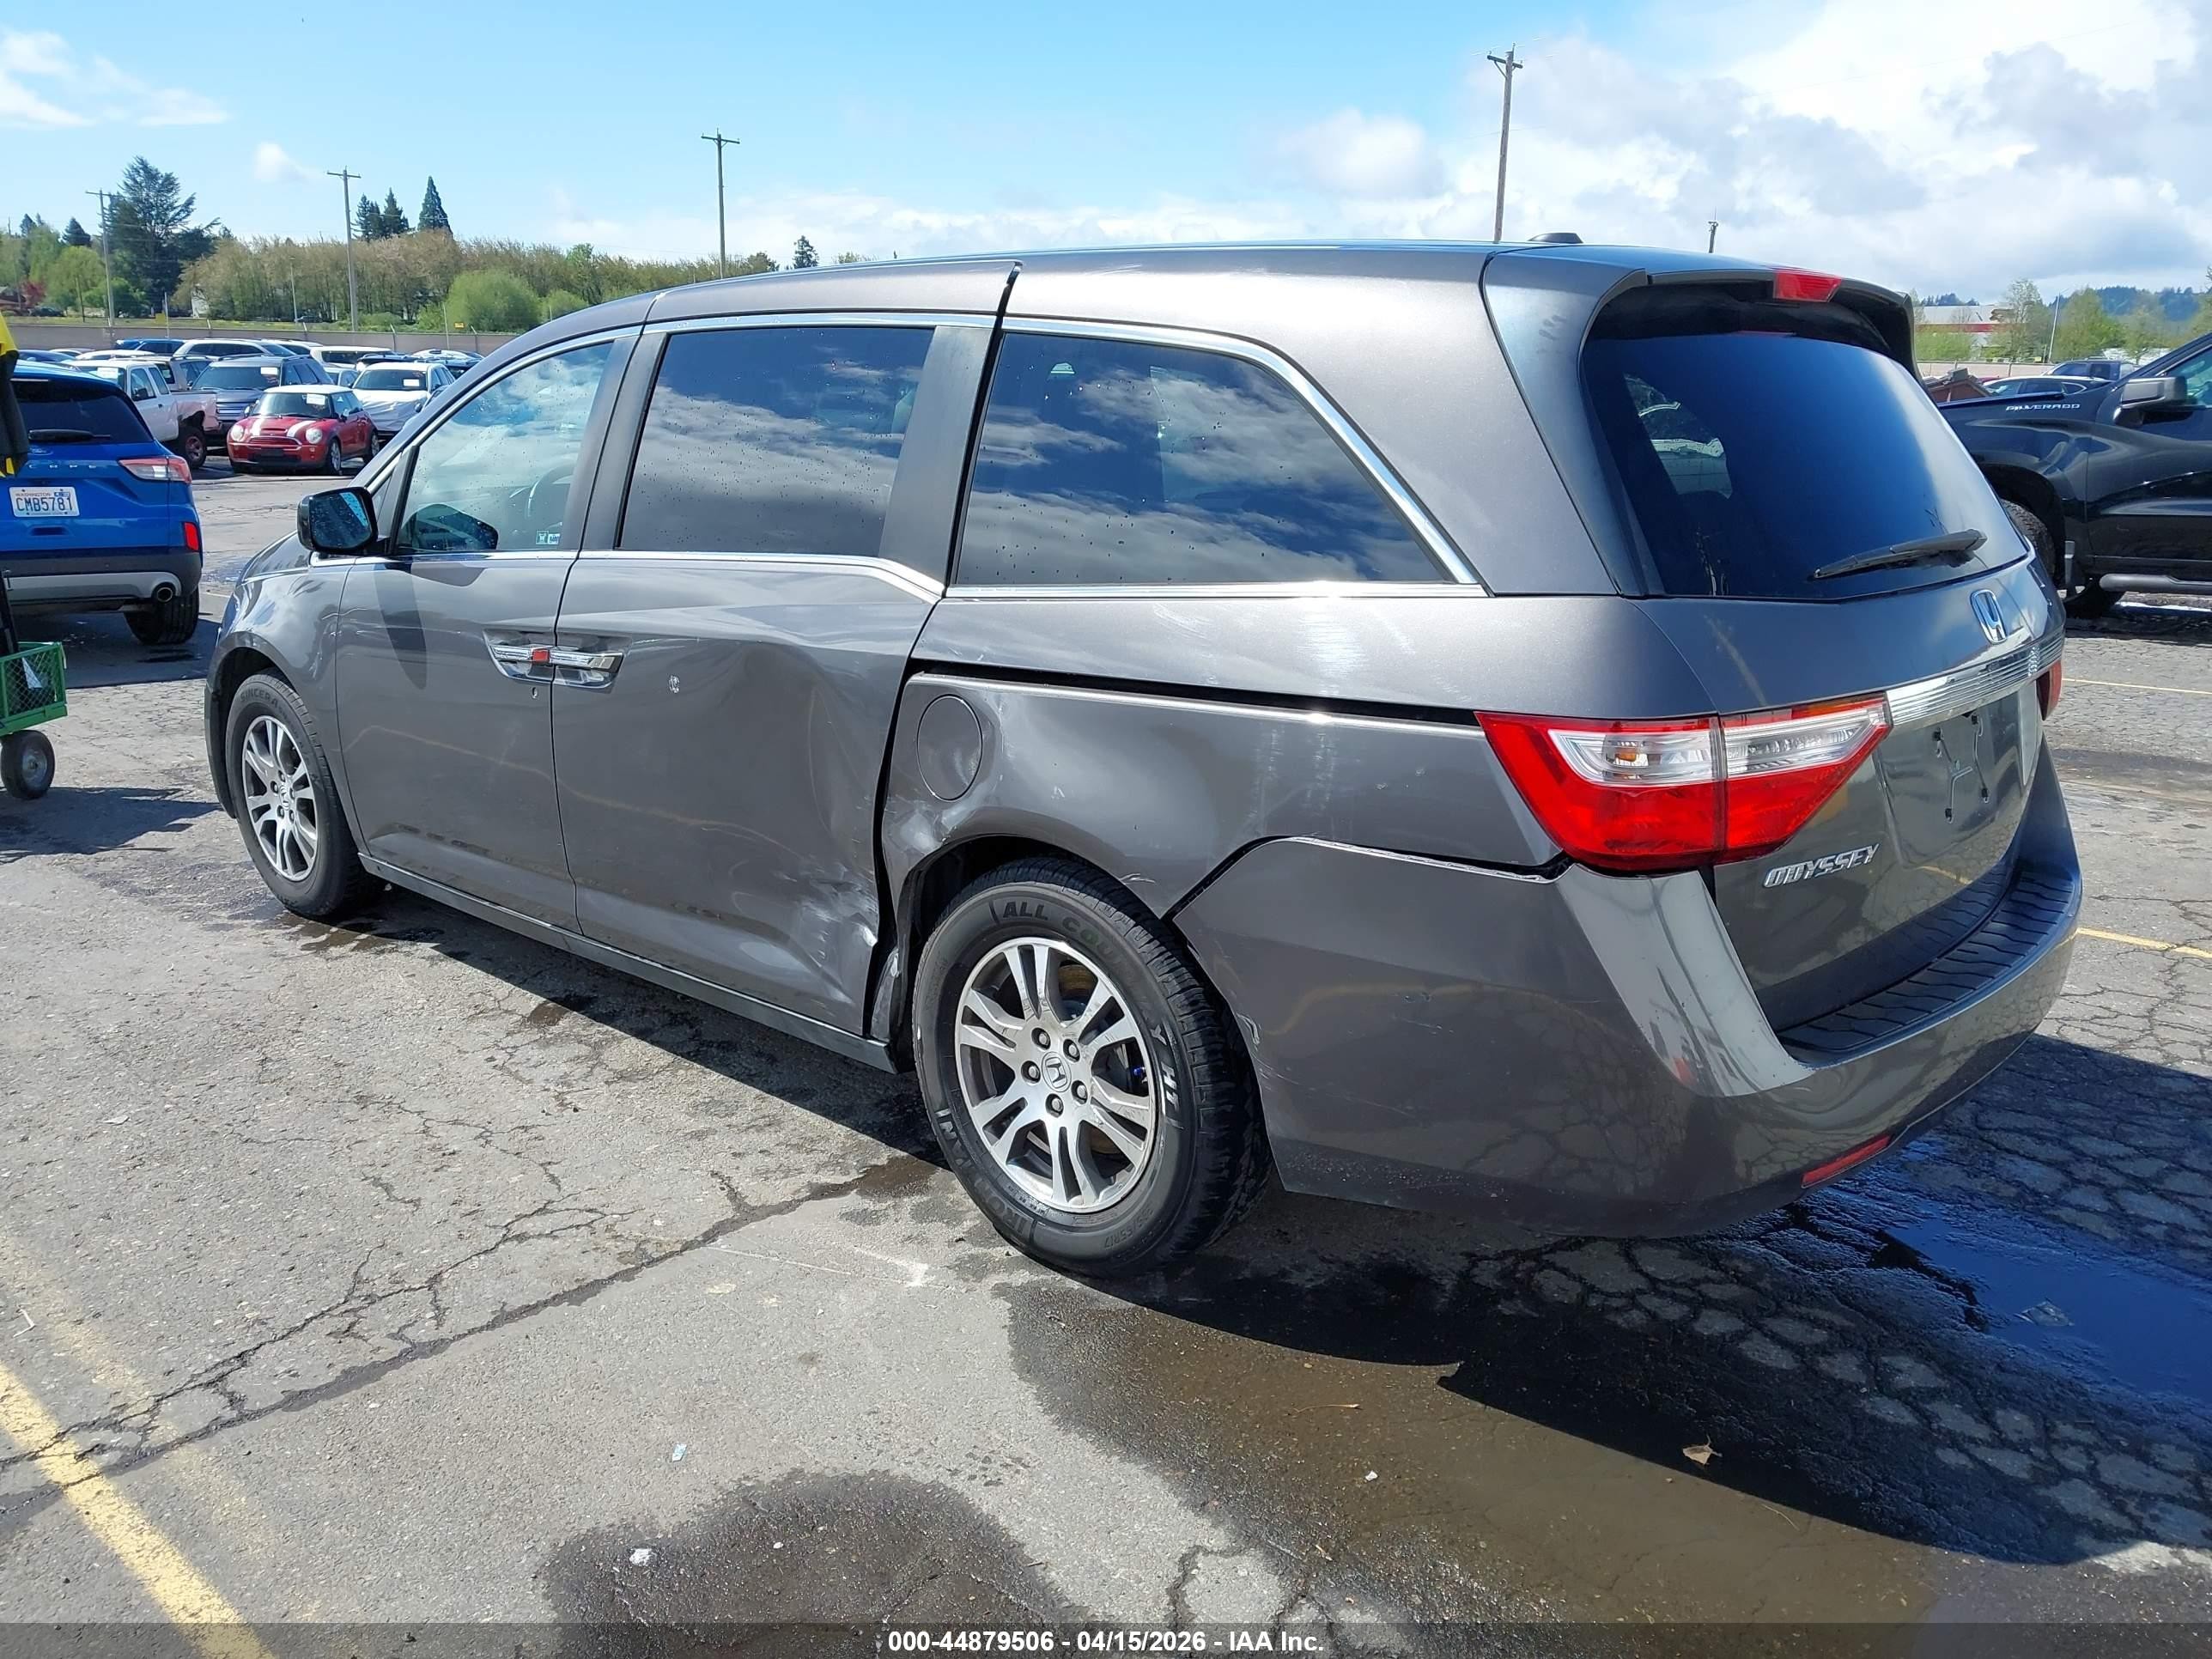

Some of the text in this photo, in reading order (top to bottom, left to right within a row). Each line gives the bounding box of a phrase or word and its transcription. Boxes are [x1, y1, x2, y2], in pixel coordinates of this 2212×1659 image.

[2005, 400, 2081, 410] SILVERADO
[15, 496, 73, 512] CMB5781
[1763, 843, 1880, 887] ODYSSEY
[1002, 902, 1048, 921] ALL
